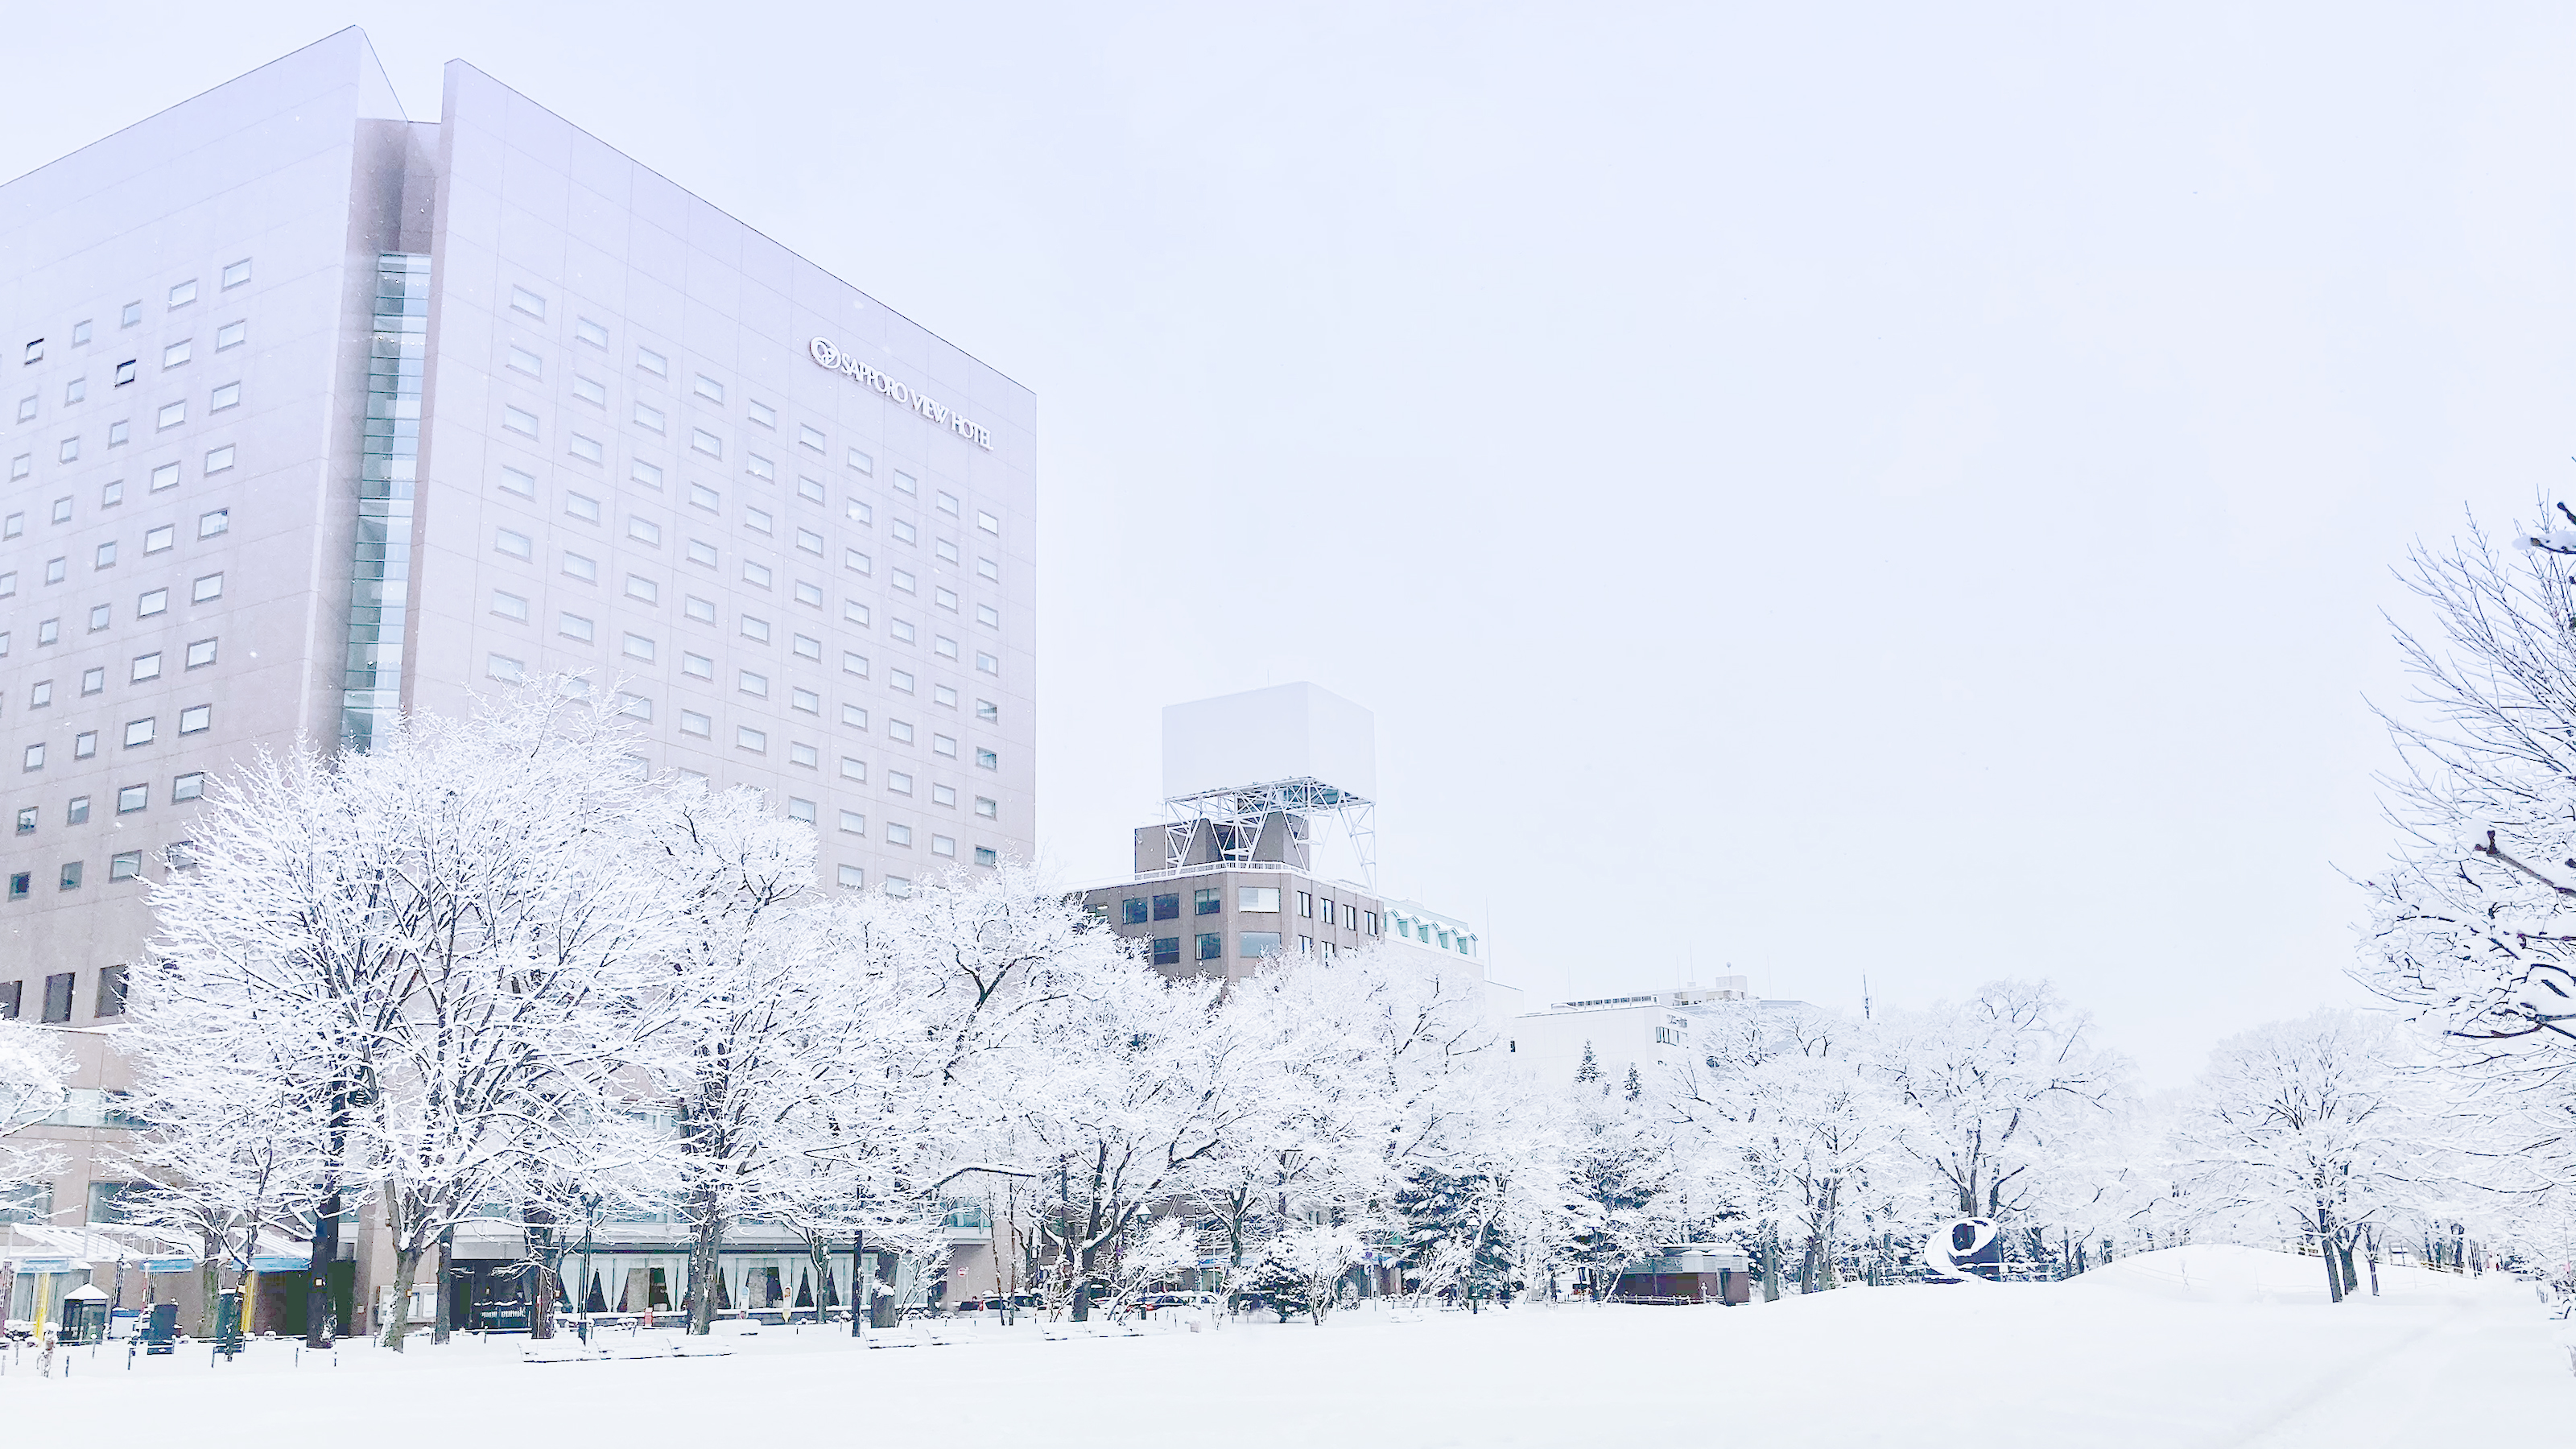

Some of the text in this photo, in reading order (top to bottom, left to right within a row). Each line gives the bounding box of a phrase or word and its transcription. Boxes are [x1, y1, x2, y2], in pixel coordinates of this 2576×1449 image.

[840, 353, 993, 451] SAPPORO VIEW HOTEL
